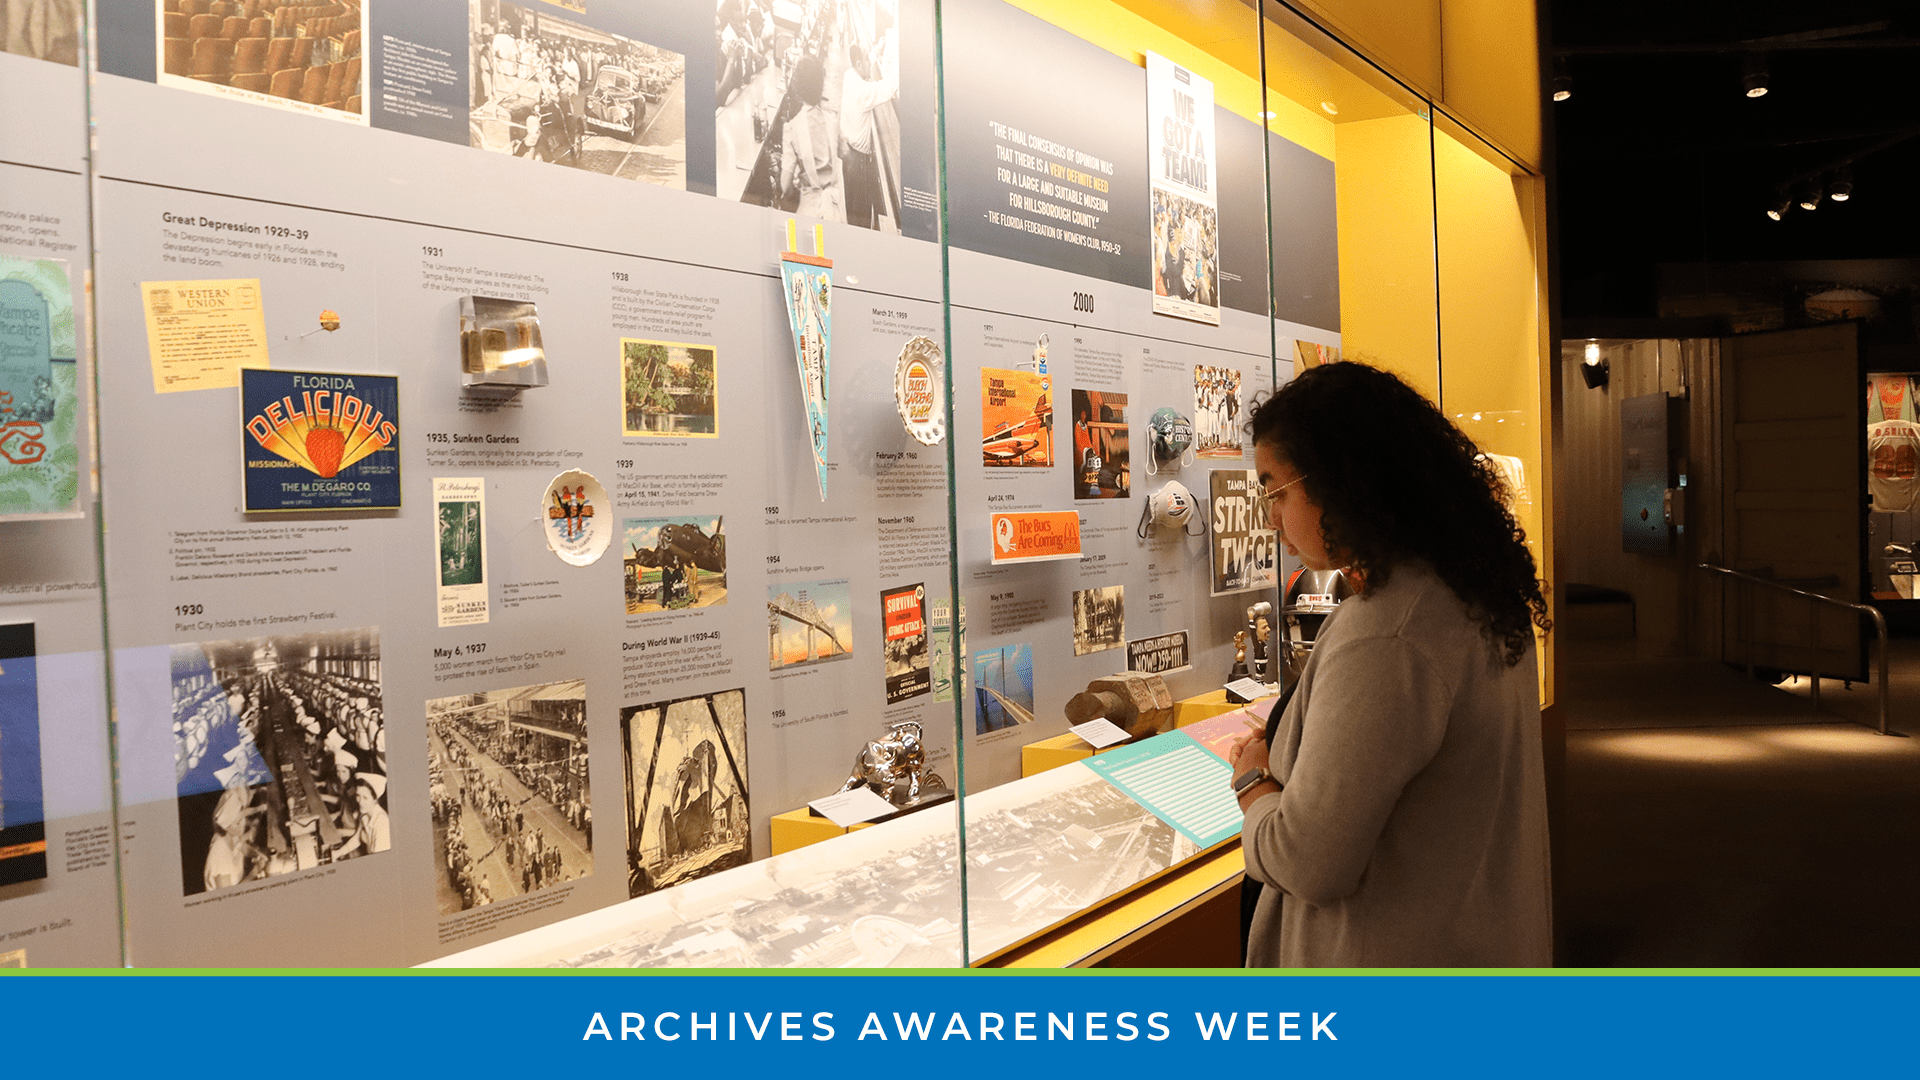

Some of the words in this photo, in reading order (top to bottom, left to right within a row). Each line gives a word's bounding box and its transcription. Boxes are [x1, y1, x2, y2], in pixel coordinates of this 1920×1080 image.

[1173, 88, 1195, 127] WE
[1163, 116, 1192, 156] GOT
[1194, 130, 1206, 161] A
[1008, 126, 1028, 146] FINAL
[1028, 134, 1066, 159] CONSENSUS
[1066, 148, 1074, 162] OF
[1076, 151, 1100, 171] OPINION
[1100, 159, 1114, 176] WAS
[996, 144, 1013, 162] THAT
[1014, 150, 1035, 170] THERE
[1036, 158, 1043, 172] IS
[1044, 160, 1050, 174] A
[1050, 162, 1066, 180] VERY
[1067, 168, 1092, 188] DEFINITE
[1094, 177, 1109, 193] NEED
[1162, 146, 1208, 193] TEAM!
[998, 167, 1011, 184] FOR
[1012, 172, 1018, 186] A
[1018, 174, 1039, 192] LARGE
[1040, 180, 1054, 196] AND
[1055, 184, 1082, 206] SUITABLE
[1084, 194, 1108, 213] MUSEUM
[1010, 192, 1022, 209] FOR
[1024, 196, 1071, 222] HILLSBOROUGH
[163, 212, 195, 226] Great
[199, 217, 260, 235] Depression
[988, 210, 1000, 225] THE
[1000, 214, 1024, 230] FLORIDA
[1024, 220, 1056, 240] FEDERATION
[1056, 228, 1064, 240] OF
[1087, 236, 1101, 252] CLUB,
[39, 238, 77, 252] Register
[163, 229, 178, 239] The
[181, 232, 225, 246] Depression
[227, 237, 254, 250] begins
[255, 243, 273, 252] early
[284, 244, 308, 255] Florida
[310, 248, 325, 258] with
[326, 250, 338, 258] the
[163, 242, 210, 257] devastating
[212, 248, 251, 260] hurricanes
[253, 252, 260, 260] of
[263, 253, 282, 262] 1926
[283, 256, 297, 265] and
[320, 260, 345, 272] ending
[422, 246, 444, 258] 1931
[163, 254, 176, 263] the
[178, 256, 196, 266] land
[198, 258, 224, 268] boom.
[612, 272, 629, 282] 1938
[177, 289, 230, 300] WESTERN
[187, 298, 225, 309] UNION
[1073, 291, 1094, 314] 2000
[812, 339, 820, 382] TAMPA
[293, 375, 356, 390] FLORIDA
[908, 379, 928, 392] BUSCH
[990, 377, 1004, 388] Tampa
[904, 392, 932, 405] GARDENS
[988, 386, 1016, 398] International
[990, 397, 1006, 407] Airport
[246, 390, 398, 446] DELICIOUS
[427, 434, 451, 445] 1935,
[453, 434, 484, 444] Sunken
[486, 434, 520, 444] Gardens
[876, 452, 898, 460] February
[248, 460, 302, 468] MISSIONARY
[616, 460, 634, 468] 1939
[281, 483, 300, 492] THE
[312, 482, 355, 492] DEGARO
[1226, 480, 1246, 491] TAMPA
[765, 506, 780, 514] 1950
[1213, 496, 1265, 534] STRIK
[878, 516, 902, 525] November
[903, 516, 915, 524] 1960
[1018, 518, 1033, 534] The
[1034, 518, 1052, 533] Bucs
[1018, 534, 1033, 550] Are
[1034, 531, 1064, 551] Coming
[766, 556, 780, 564] 1954
[1220, 534, 1274, 575] TWICE
[174, 604, 204, 616] 1930
[887, 594, 918, 614] SURVIVAL
[175, 622, 196, 632] Plant
[198, 621, 214, 631] City
[216, 619, 237, 629] holds
[238, 618, 251, 626] the
[253, 616, 268, 626] first
[269, 612, 308, 625] Strawberry
[310, 610, 338, 621] Festival.
[888, 623, 904, 637] ATOMIC
[904, 620, 920, 633] ATTACK
[434, 648, 453, 659] May
[455, 646, 464, 656] 6,
[466, 644, 486, 654] 1937
[622, 641, 646, 652] During
[647, 637, 668, 648] World
[669, 636, 682, 644] War
[434, 663, 452, 672] 5,000
[453, 660, 475, 669] women
[476, 658, 494, 667] march
[496, 656, 508, 665] from
[509, 654, 524, 662] Ybor
[524, 652, 537, 662] City
[544, 650, 556, 660] City
[556, 648, 567, 657] Hall
[443, 670, 464, 682] protest
[476, 668, 488, 677] rise
[496, 665, 516, 675] fascism
[898, 682, 930, 696] GOVERNMENT
[772, 708, 786, 718] 1956
[8, 925, 38, 940] tower
[40, 922, 48, 932] is
